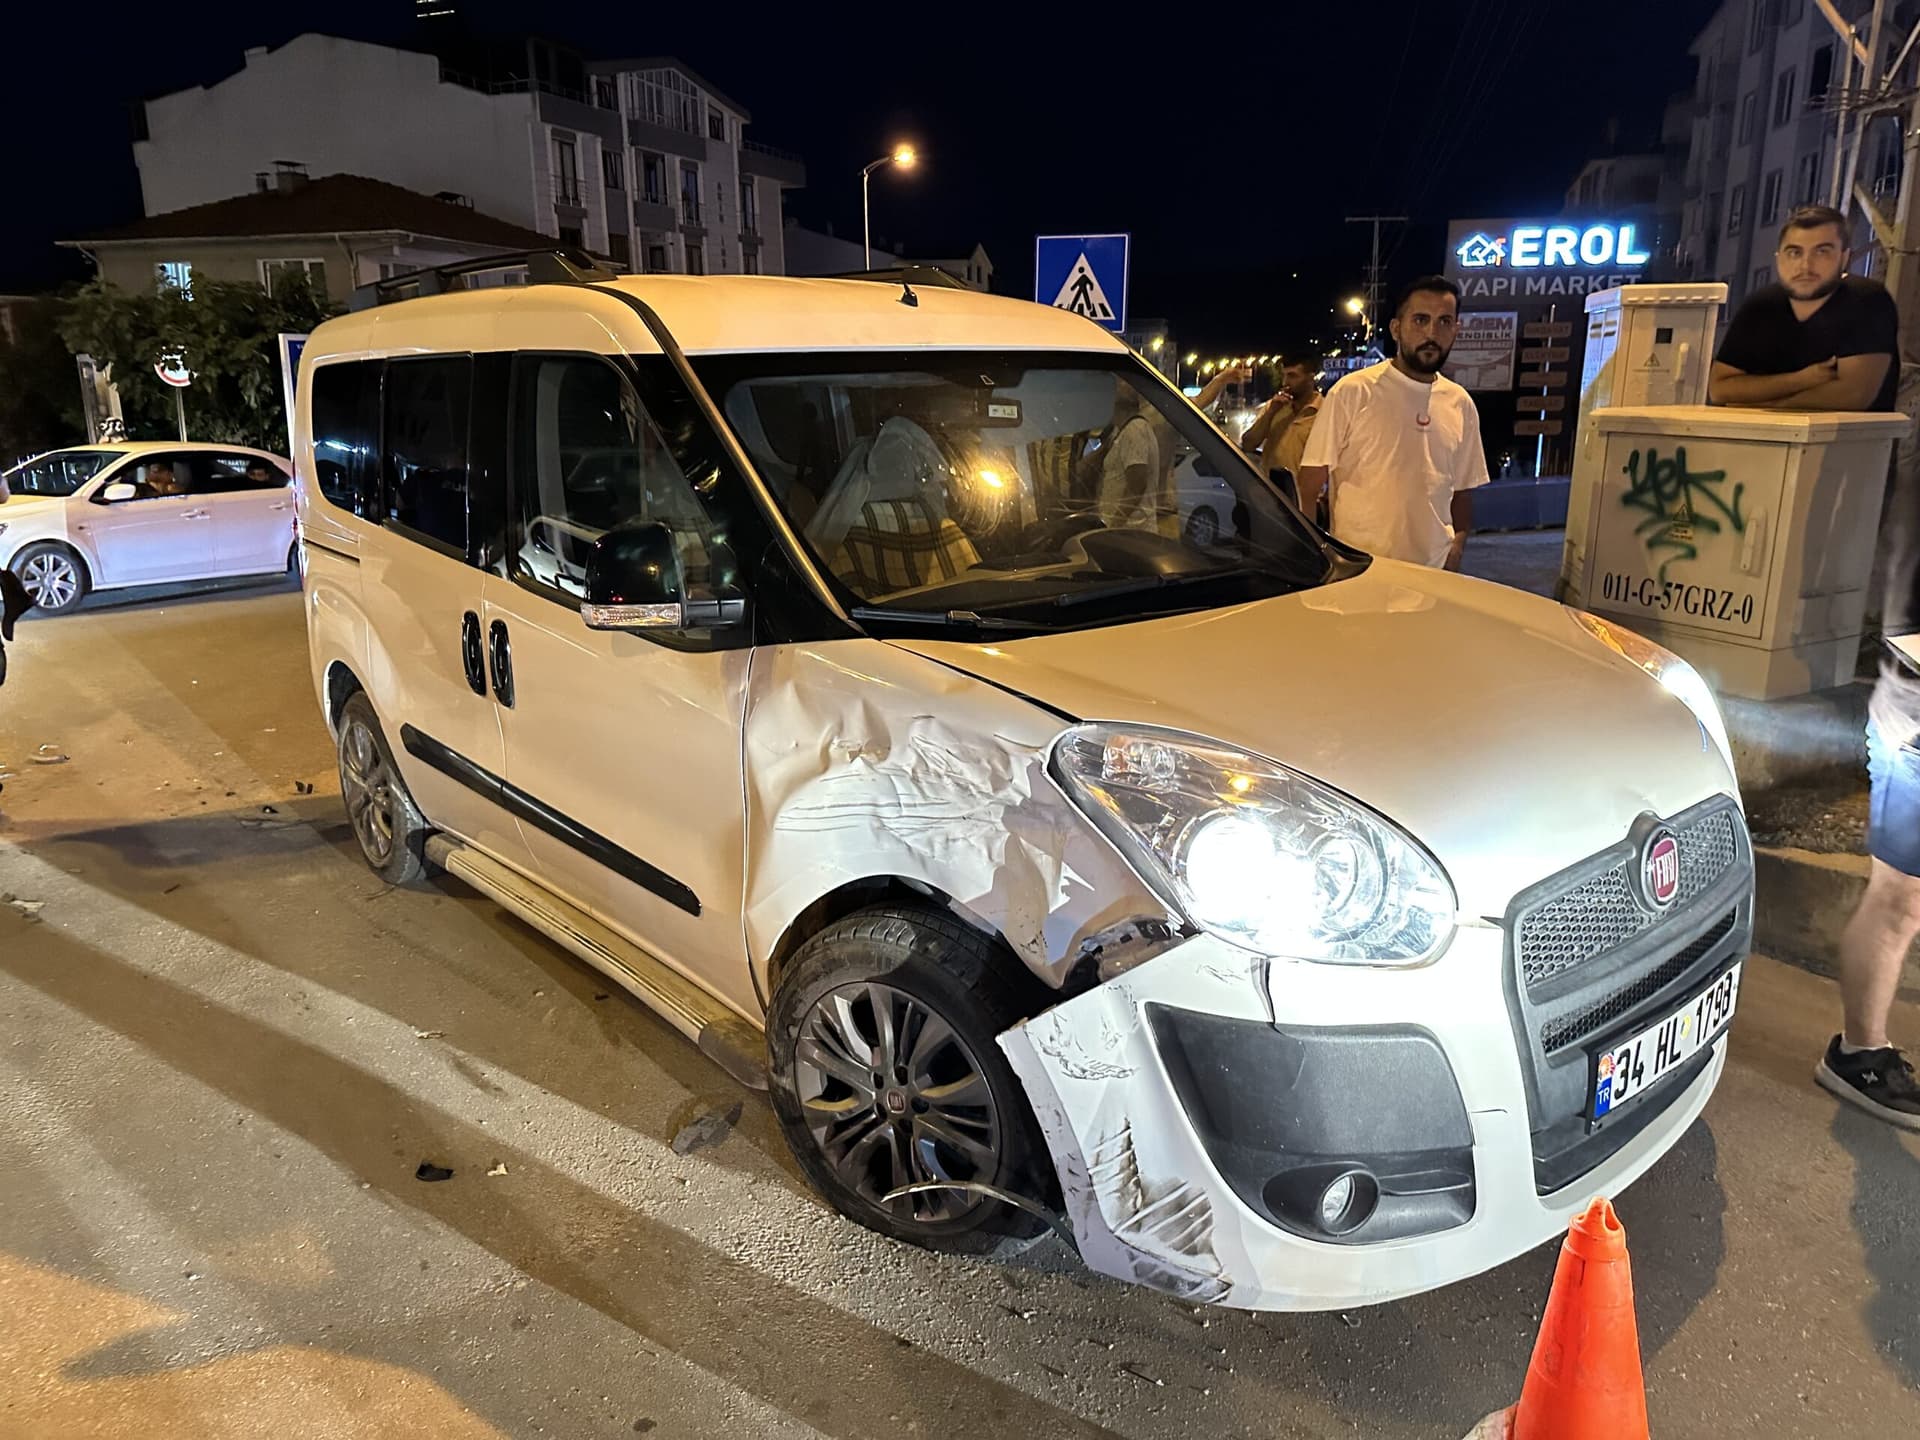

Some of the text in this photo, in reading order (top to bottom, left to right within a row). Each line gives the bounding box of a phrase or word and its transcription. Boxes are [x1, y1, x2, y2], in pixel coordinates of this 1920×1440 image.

[1511, 225, 1650, 267] EROL
[1457, 277, 1516, 297] YAPI
[1603, 571, 1753, 625] 011-G-57GRZ-0
[1655, 849, 1675, 889] FIAT
[1614, 971, 1733, 1100] 34 HL 1798
[1598, 1086, 1610, 1105] TR
